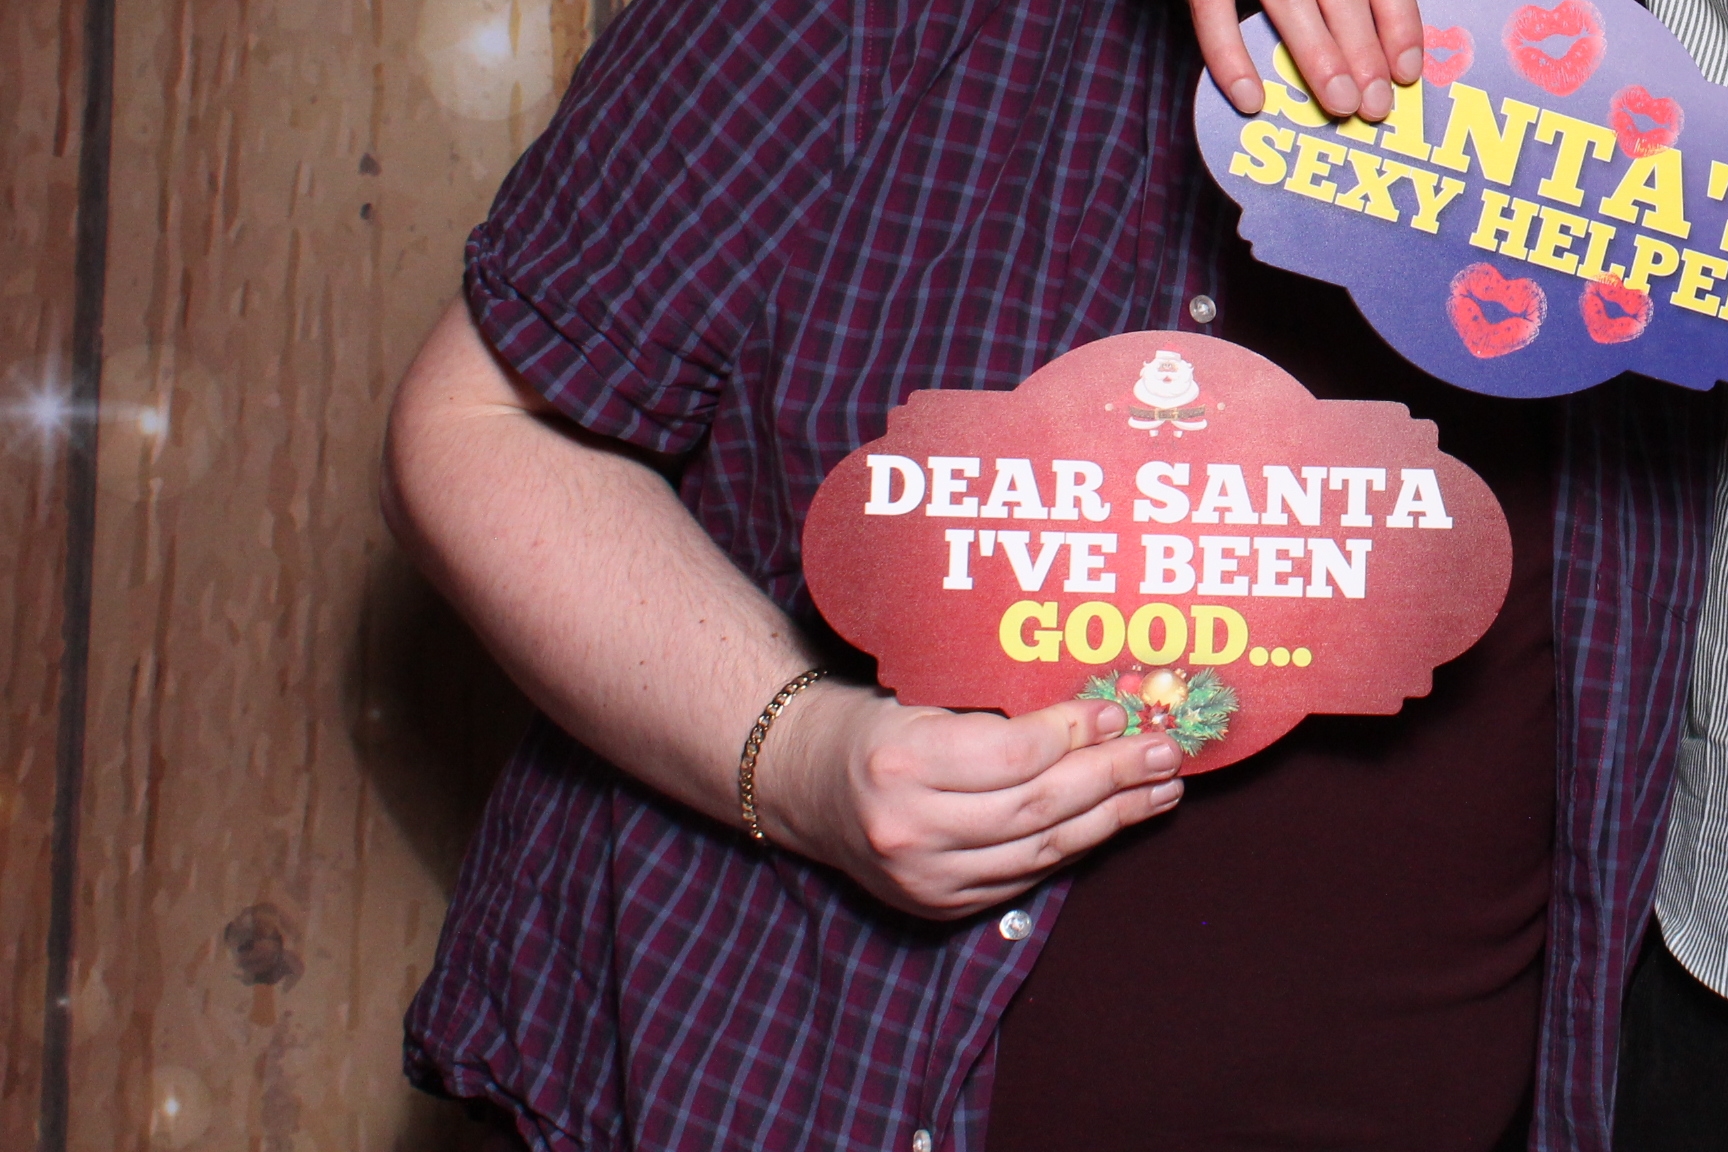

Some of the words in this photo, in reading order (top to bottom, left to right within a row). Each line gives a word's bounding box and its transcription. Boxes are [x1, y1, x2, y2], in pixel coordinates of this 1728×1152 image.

[1229, 119, 1464, 235] SEXY
[864, 454, 1111, 521] DEAR
[1133, 461, 1454, 529] SANTA
[942, 529, 1118, 593] I'VE
[1139, 537, 1373, 598] BEEN
